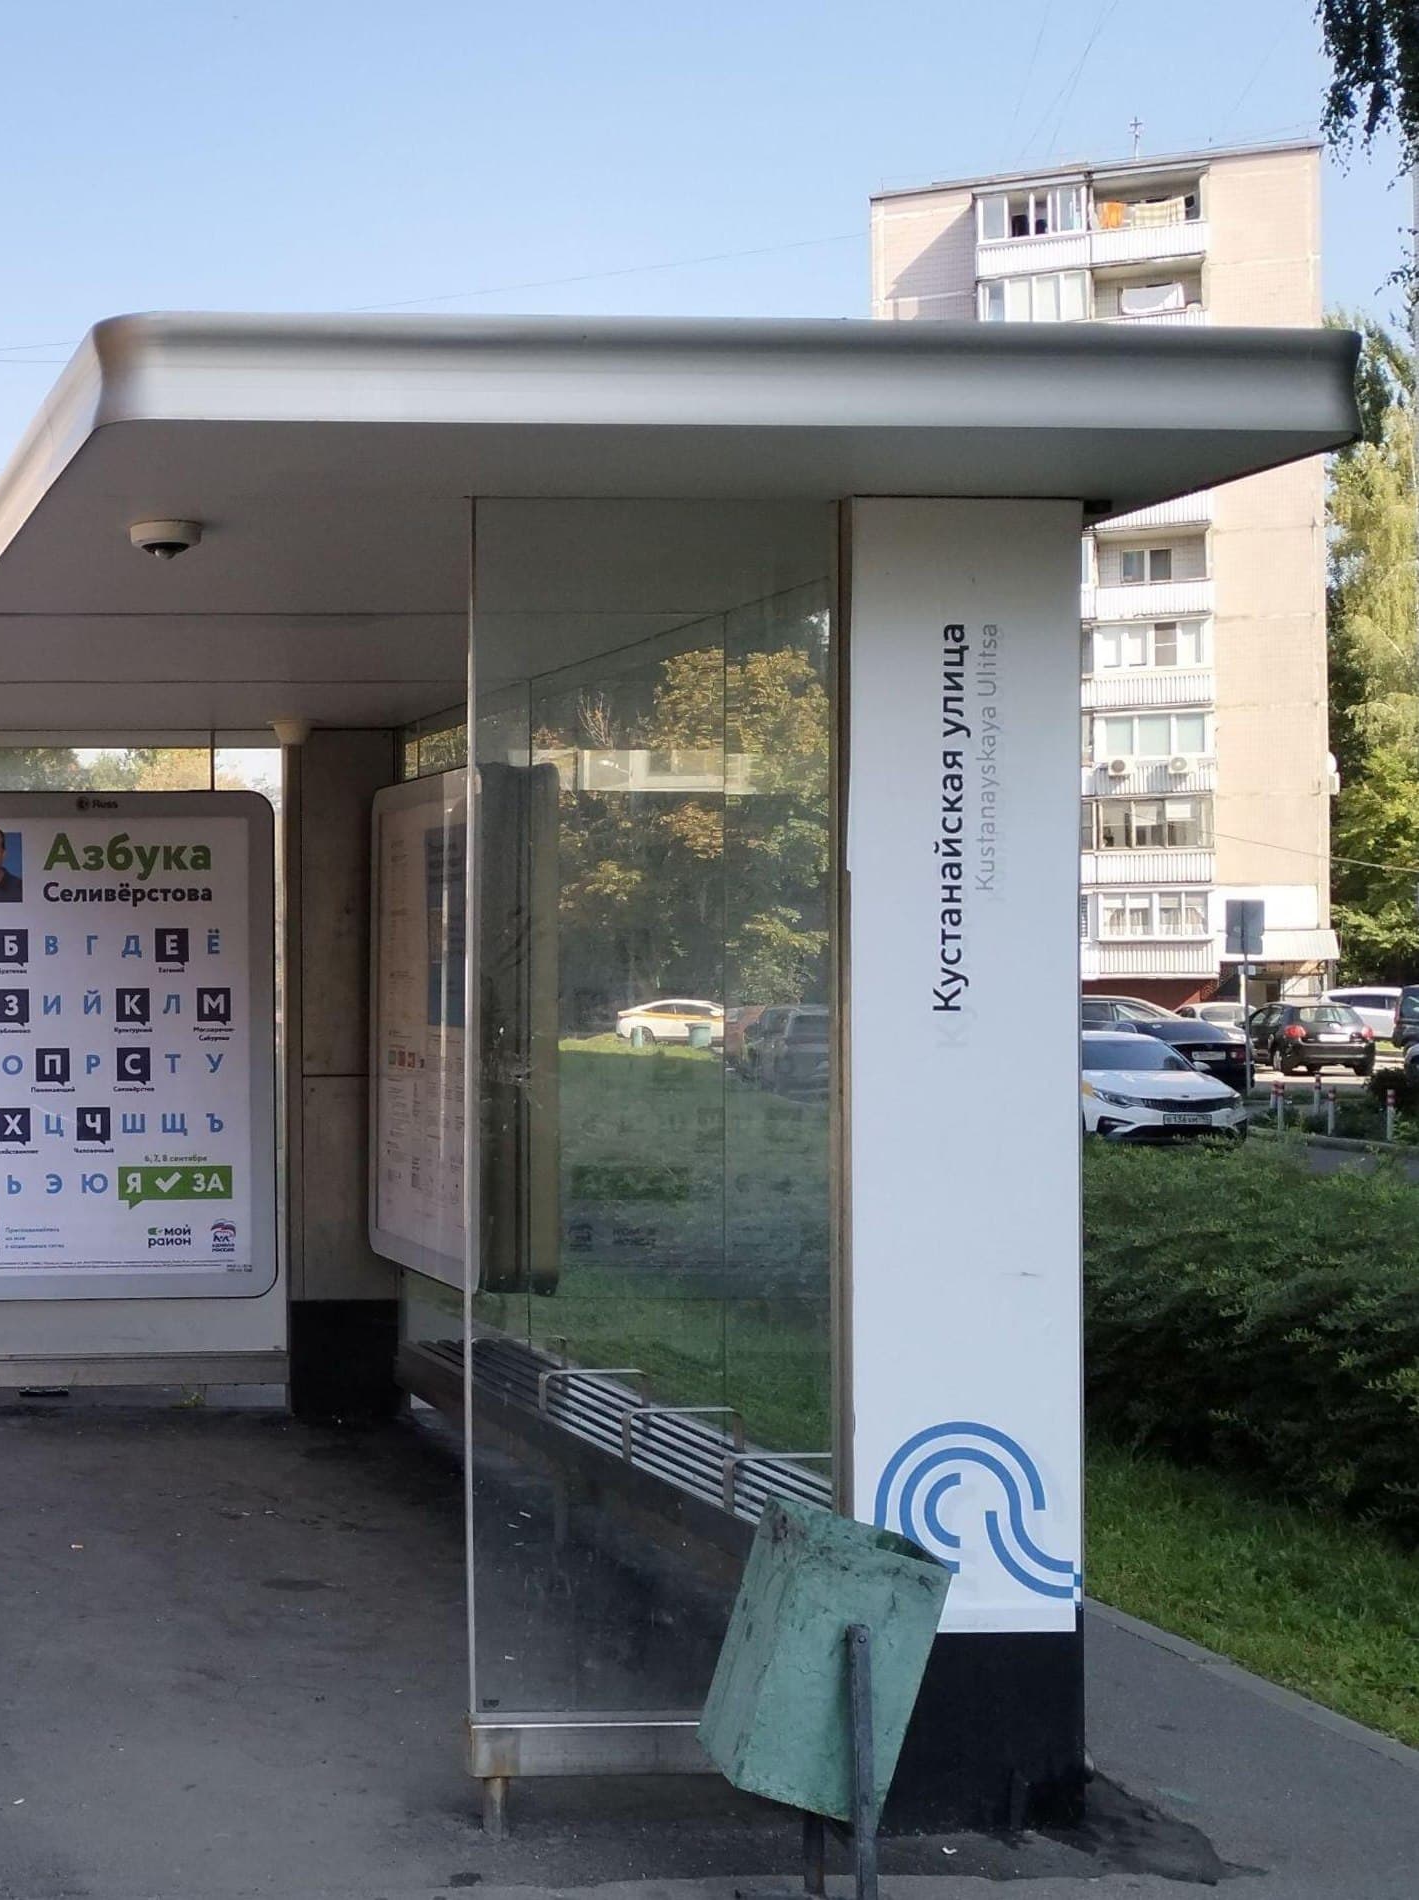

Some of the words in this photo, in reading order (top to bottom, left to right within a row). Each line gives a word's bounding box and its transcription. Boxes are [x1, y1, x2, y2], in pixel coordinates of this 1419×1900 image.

[975, 622, 999, 697] Ulitsa
[942, 623, 972, 739] улица
[974, 705, 1003, 891] Kustanayskaya
[43, 831, 212, 882] Азбука
[43, 881, 213, 908] Селивёрстова
[932, 750, 970, 1012] Кустанайская
[3, 935, 19, 957] Б
[44, 935, 59, 956] В
[86, 934, 99, 956] Г
[121, 934, 143, 959] Д
[165, 934, 179, 956] Е
[207, 928, 221, 955] Ё
[4, 994, 19, 1016] З
[42, 994, 62, 1016] И
[83, 989, 102, 1015] Й
[124, 994, 142, 1016] К
[162, 993, 181, 1015] Л
[203, 993, 225, 1015] М
[1, 1054, 24, 1076] О
[44, 1054, 62, 1075] П
[86, 1054, 101, 1075] Р
[124, 1053, 142, 1075] С
[164, 1053, 182, 1074] Т
[205, 1053, 224, 1074] У
[3, 1114, 23, 1136] Х
[44, 1114, 65, 1138] Ц
[85, 1113, 102, 1135] Ч
[121, 1113, 146, 1134] Ш
[161, 1112, 189, 1137] Щ
[205, 1112, 224, 1133] Ъ
[161, 1154, 168, 1163] 8
[169, 1153, 208, 1164] сентября
[7, 1174, 22, 1195] Ь
[45, 1173, 63, 1195] Э
[81, 1172, 109, 1194] Ю
[126, 1172, 142, 1194] Я
[192, 1172, 225, 1193] ЗА
[147, 1236, 192, 1249] район
[164, 1223, 192, 1236] мой
